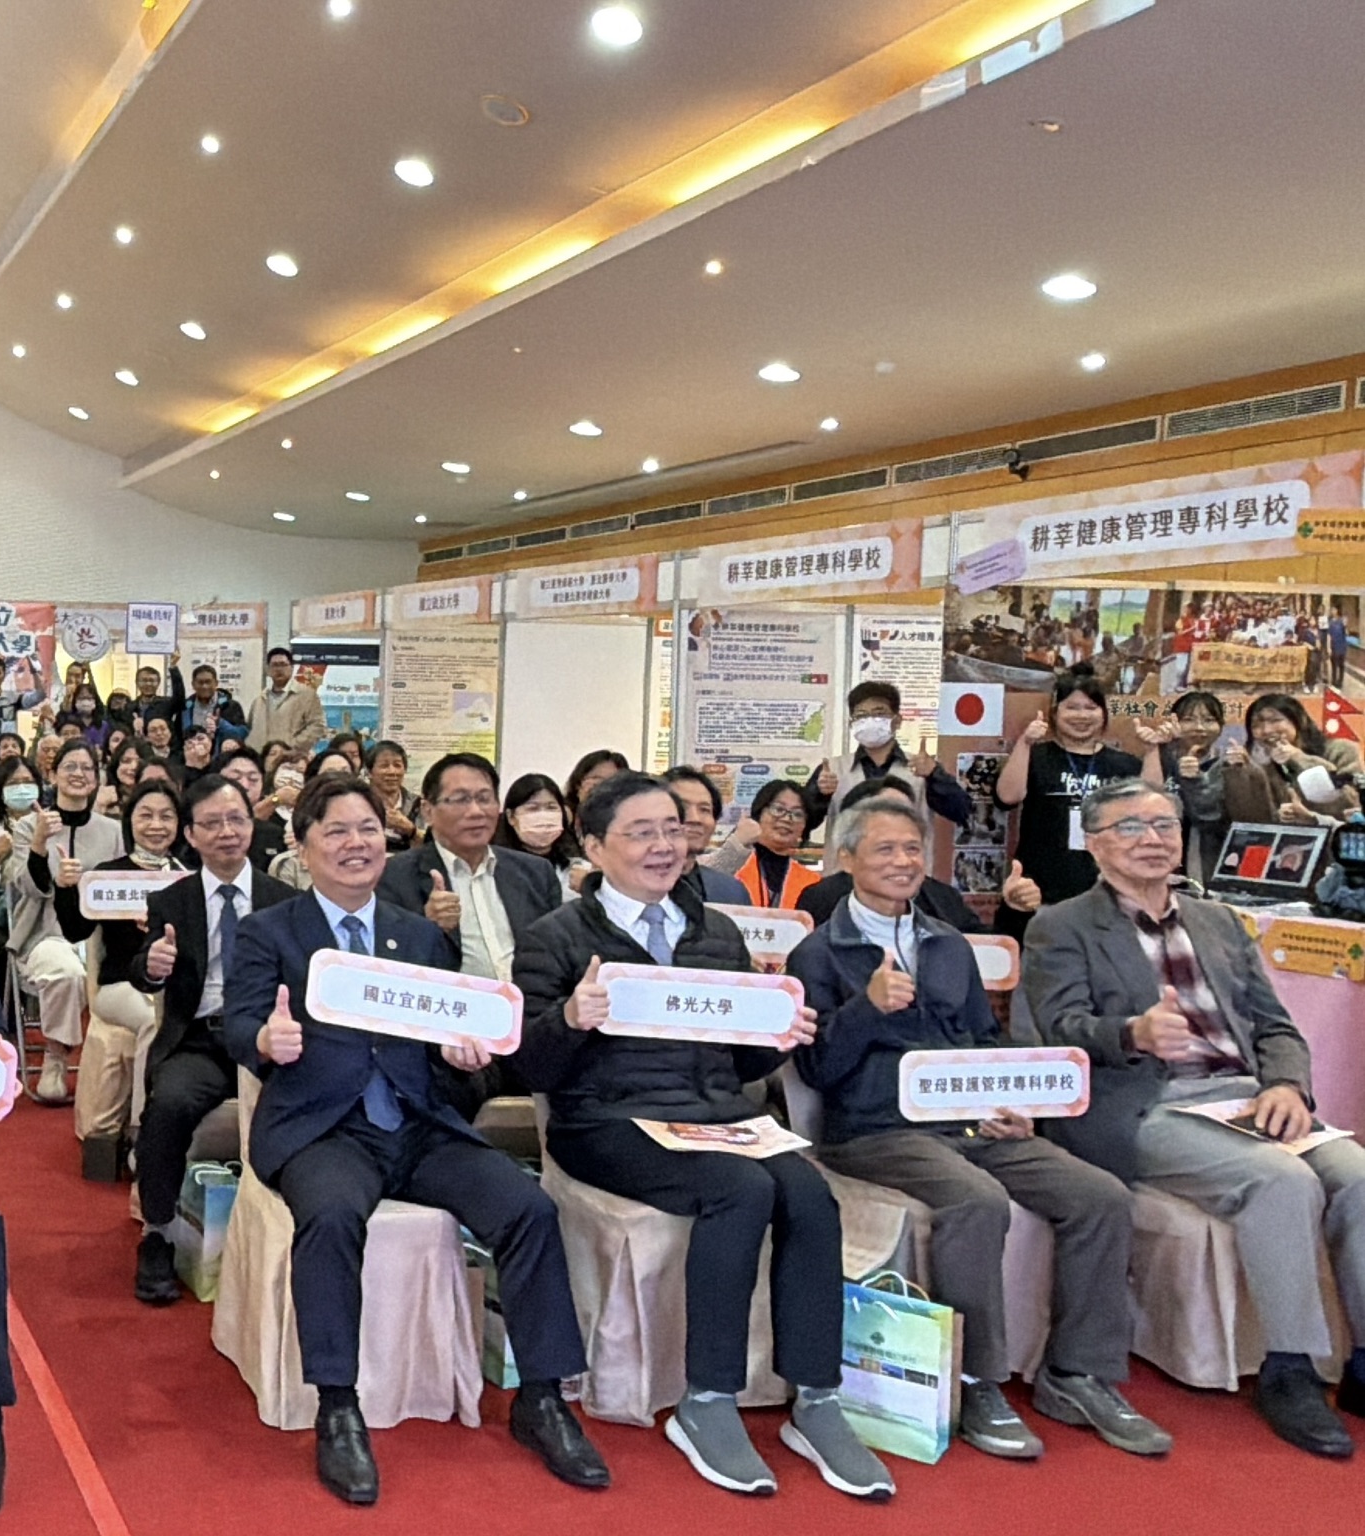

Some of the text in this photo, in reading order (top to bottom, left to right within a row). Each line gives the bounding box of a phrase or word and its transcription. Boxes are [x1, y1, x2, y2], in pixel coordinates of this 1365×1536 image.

[1029, 493, 1291, 553] 耕莘健康管理專科學校
[727, 546, 882, 584] 耕莘健康管理專科學校
[195, 612, 250, 626] 理科技大學
[363, 984, 468, 1018] 國立宜蘭大學
[665, 994, 733, 1015] 佛光大學
[918, 1074, 1075, 1094] 聖母醫護管理專科學校
